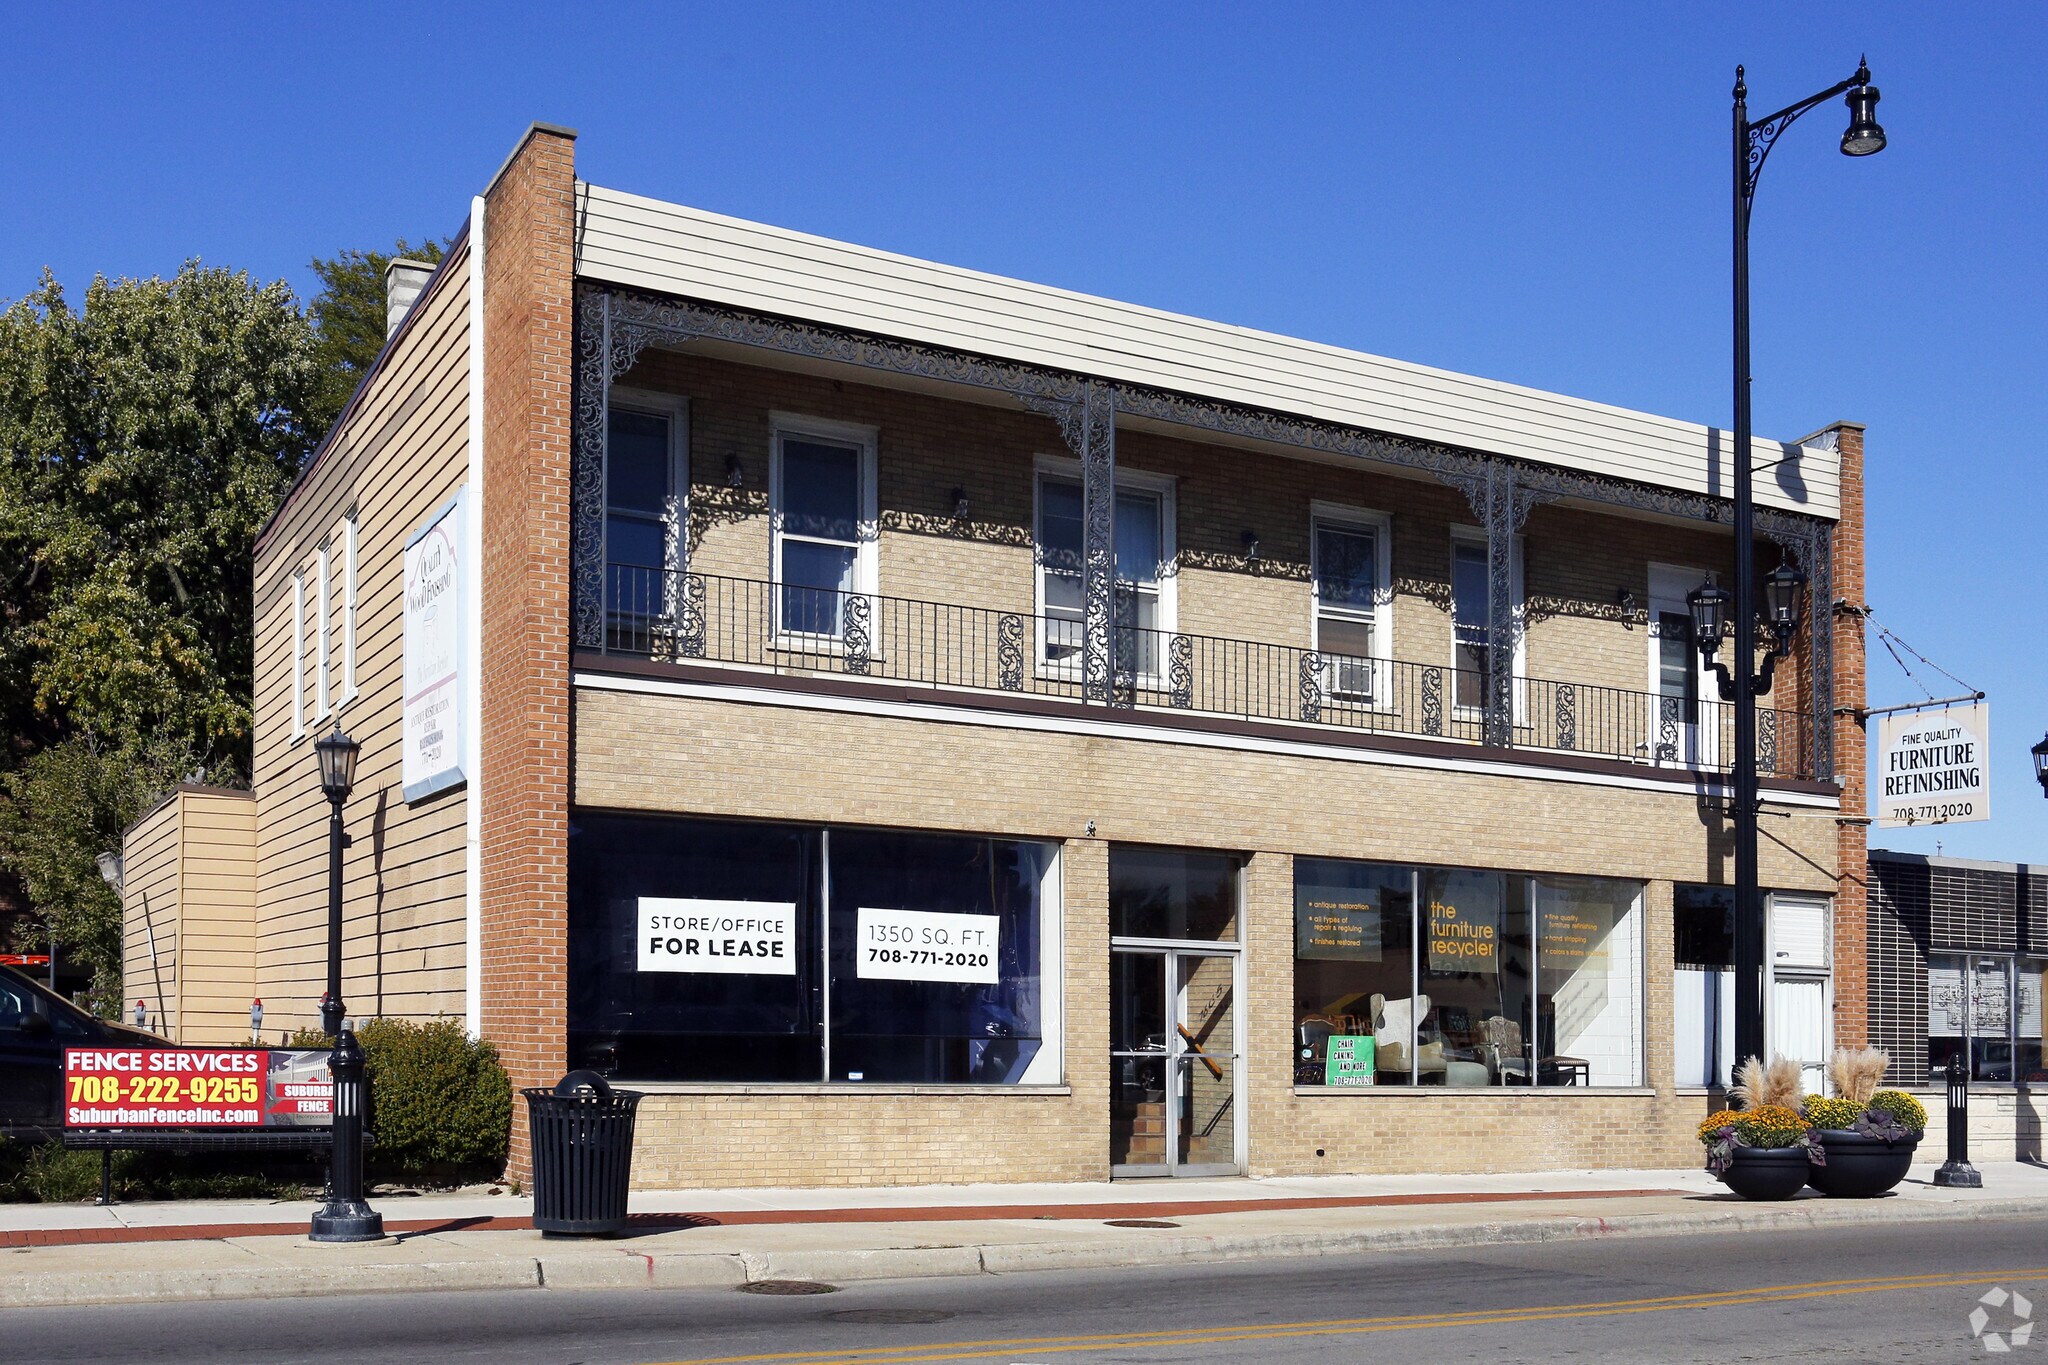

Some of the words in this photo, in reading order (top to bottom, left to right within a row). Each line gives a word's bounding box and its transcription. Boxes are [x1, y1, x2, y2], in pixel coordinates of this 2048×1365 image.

[1902, 733, 1921, 745] FINE
[1924, 728, 1961, 743] QUALITY
[1890, 743, 1975, 771] FURNITURE
[1885, 767, 1980, 796] REFINISHING
[1314, 902, 1337, 910] antique
[1338, 903, 1369, 911] restoration
[1431, 901, 1456, 919] the
[651, 916, 784, 933] STORE/OFFICE
[1560, 914, 1578, 923] quality
[869, 925, 914, 943] 1350
[922, 927, 954, 945] SQ.
[962, 929, 990, 947] FT.
[1431, 919, 1493, 939] furniture
[650, 937, 700, 955] FOR
[708, 939, 784, 958] LEASE
[1337, 939, 1361, 947] restored
[1431, 939, 1494, 959] recycler
[868, 948, 989, 967] 708-771-2020
[1337, 1039, 1354, 1049] CHAIR
[68, 1052, 142, 1071] FENCE
[148, 1053, 259, 1072] SERVICES
[1339, 1062, 1351, 1071] AND
[68, 1076, 259, 1103] 708-222-9255
[284, 1085, 334, 1097] SUBURBA
[69, 1107, 259, 1123] SuburbanFenceInc.com
[297, 1101, 329, 1112] FENCE
